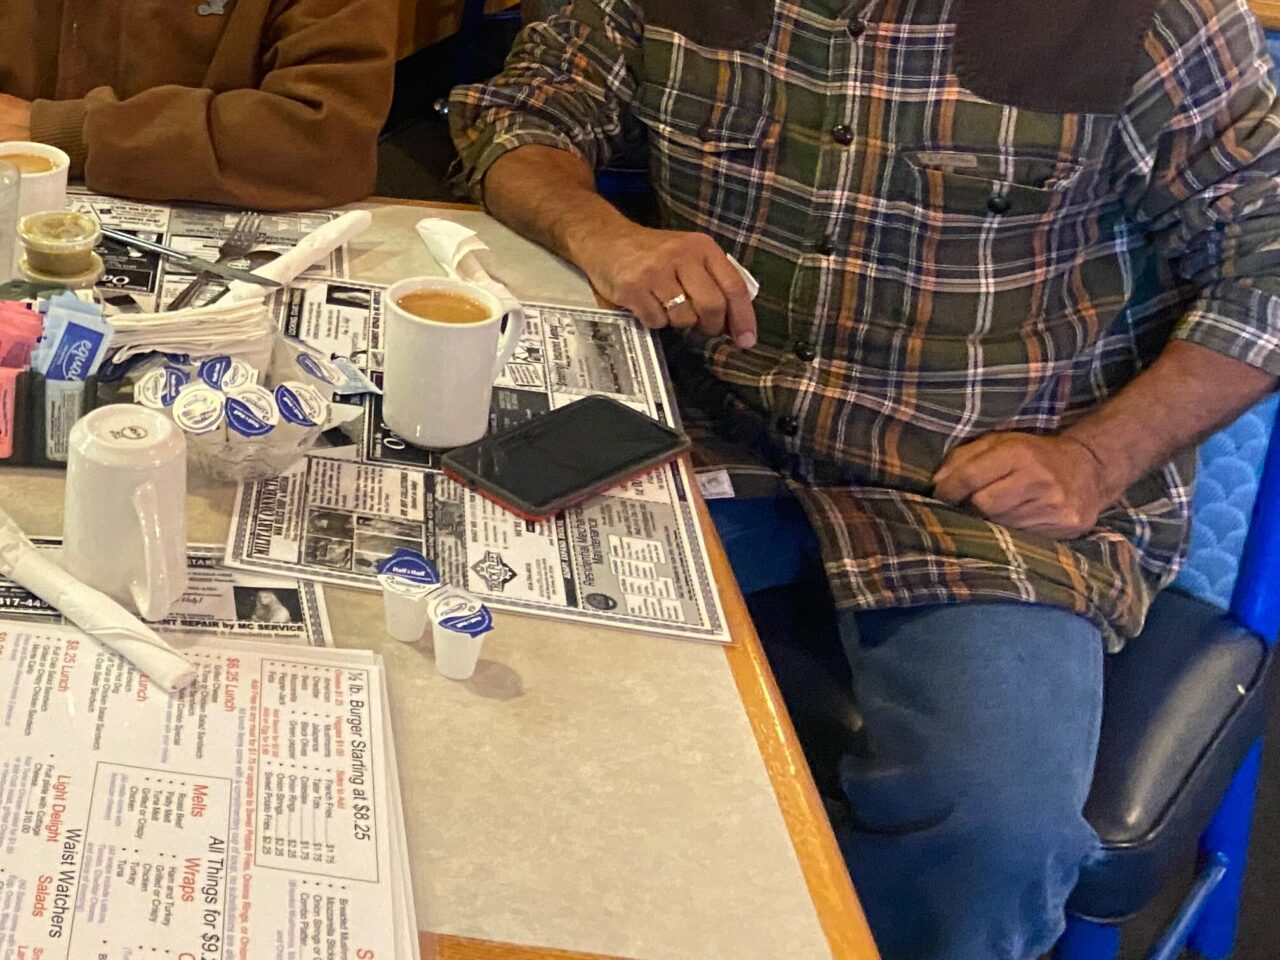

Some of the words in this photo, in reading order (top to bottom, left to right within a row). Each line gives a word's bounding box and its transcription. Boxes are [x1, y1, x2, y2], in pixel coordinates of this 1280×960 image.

[253, 517, 274, 556] MILITARY
[584, 516, 605, 565] Maintenance
[180, 620, 220, 630] REPAIR
[222, 621, 235, 631] by
[237, 622, 255, 631] MC
[258, 623, 304, 632] SERVICE
[62, 639, 79, 664] $8.25
[56, 664, 73, 692] Lunch
[225, 656, 239, 682] $6.25
[347, 671, 362, 682] ½
[224, 683, 237, 712] Lunch
[348, 683, 363, 698] lb.
[345, 698, 365, 737] Burger
[346, 738, 368, 786] Starting
[50, 773, 71, 801] Light
[352, 787, 367, 801] at
[137, 808, 147, 817] or
[190, 783, 208, 819] Melts
[42, 802, 65, 843] Delight
[351, 803, 370, 842] $8.25
[59, 827, 81, 866] Waist
[207, 835, 224, 854] All
[262, 835, 271, 855] $2.25
[274, 836, 284, 857] $2.25
[286, 838, 296, 859] $2.25
[300, 840, 308, 861] $1.75
[312, 841, 321, 862] $1.75
[325, 843, 335, 864] $1.75
[126, 860, 139, 886] Turkey
[139, 862, 151, 893] Chicken
[165, 865, 176, 885] Ham
[177, 855, 200, 903] Wraps
[200, 855, 223, 905] Things
[30, 874, 53, 918] Salads
[47, 868, 74, 939] Watchers
[151, 889, 161, 898] or
[164, 886, 175, 900] and
[311, 894, 322, 917] Onion
[148, 898, 161, 923] Crispy
[162, 900, 173, 927] Turkey
[203, 908, 219, 929] for
